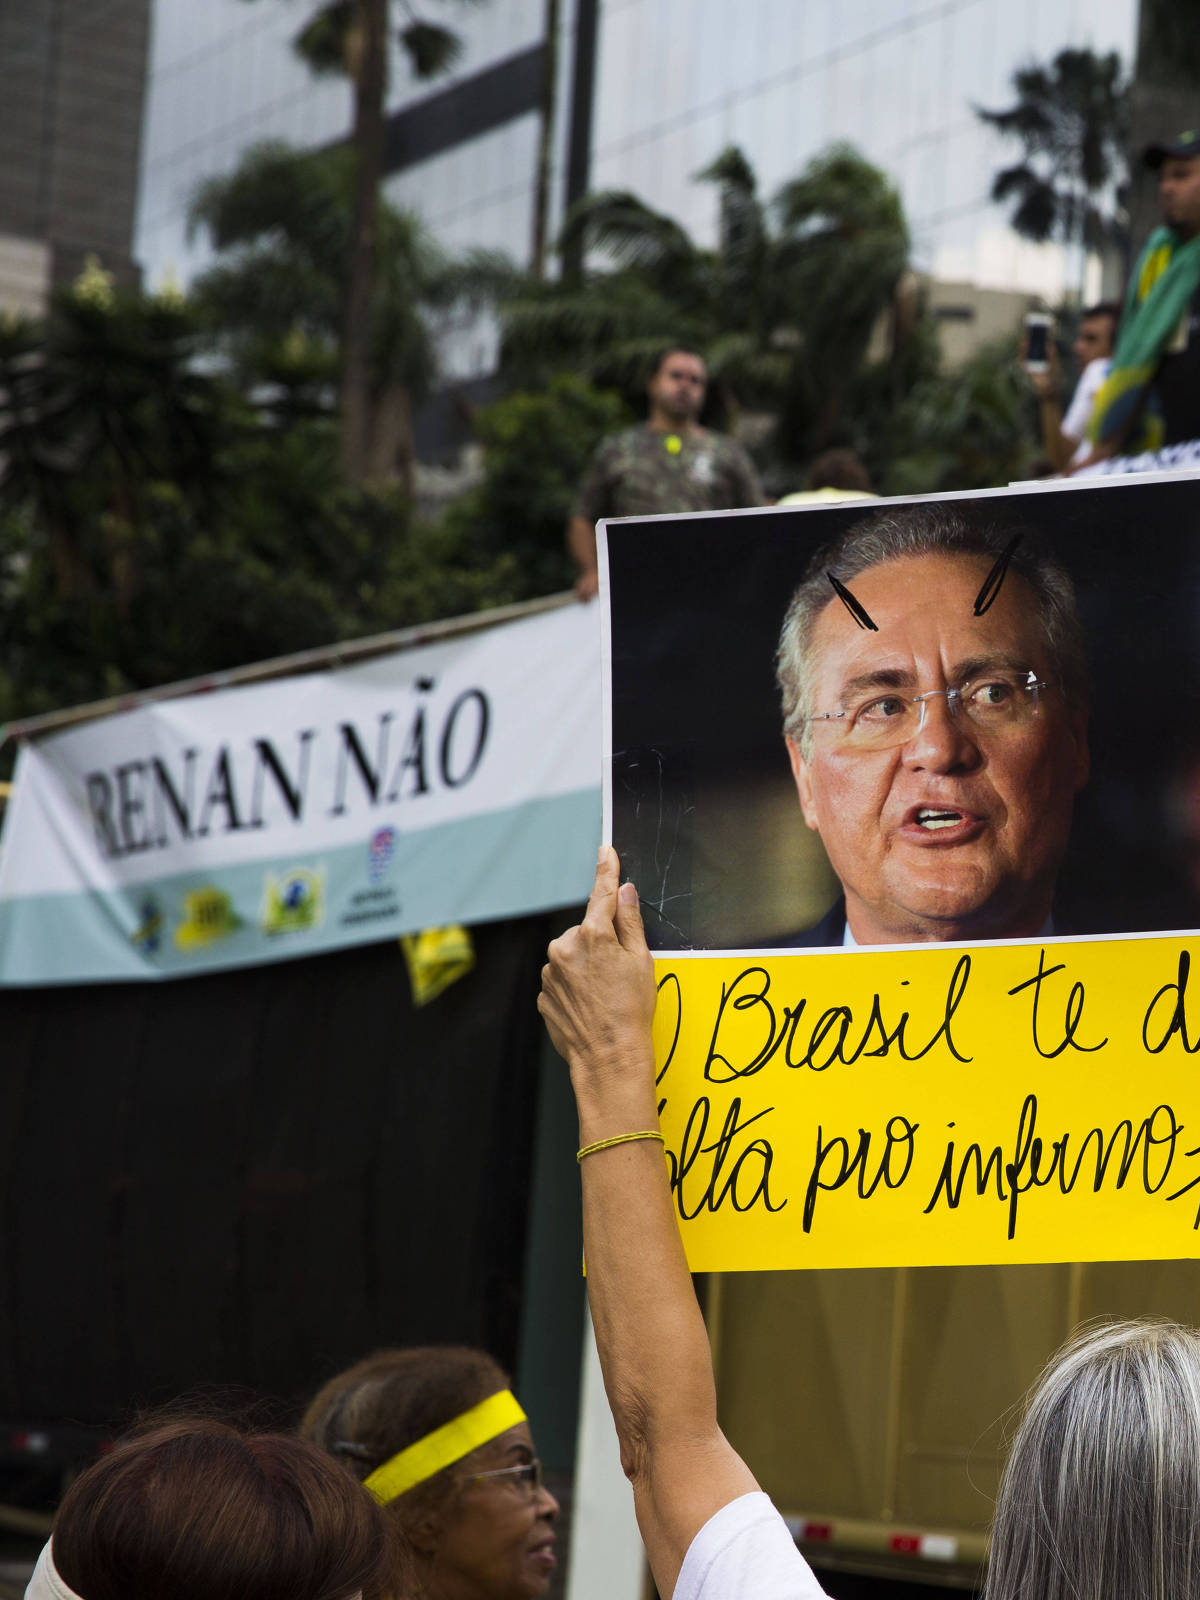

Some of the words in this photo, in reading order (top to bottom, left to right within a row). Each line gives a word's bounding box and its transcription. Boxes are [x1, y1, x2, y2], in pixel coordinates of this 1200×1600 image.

[85, 729, 317, 861] RENAN
[328, 675, 492, 818] NÃO
[704, 954, 973, 1083] Brasil
[1007, 949, 1108, 1059] te
[802, 1116, 921, 1234] pro
